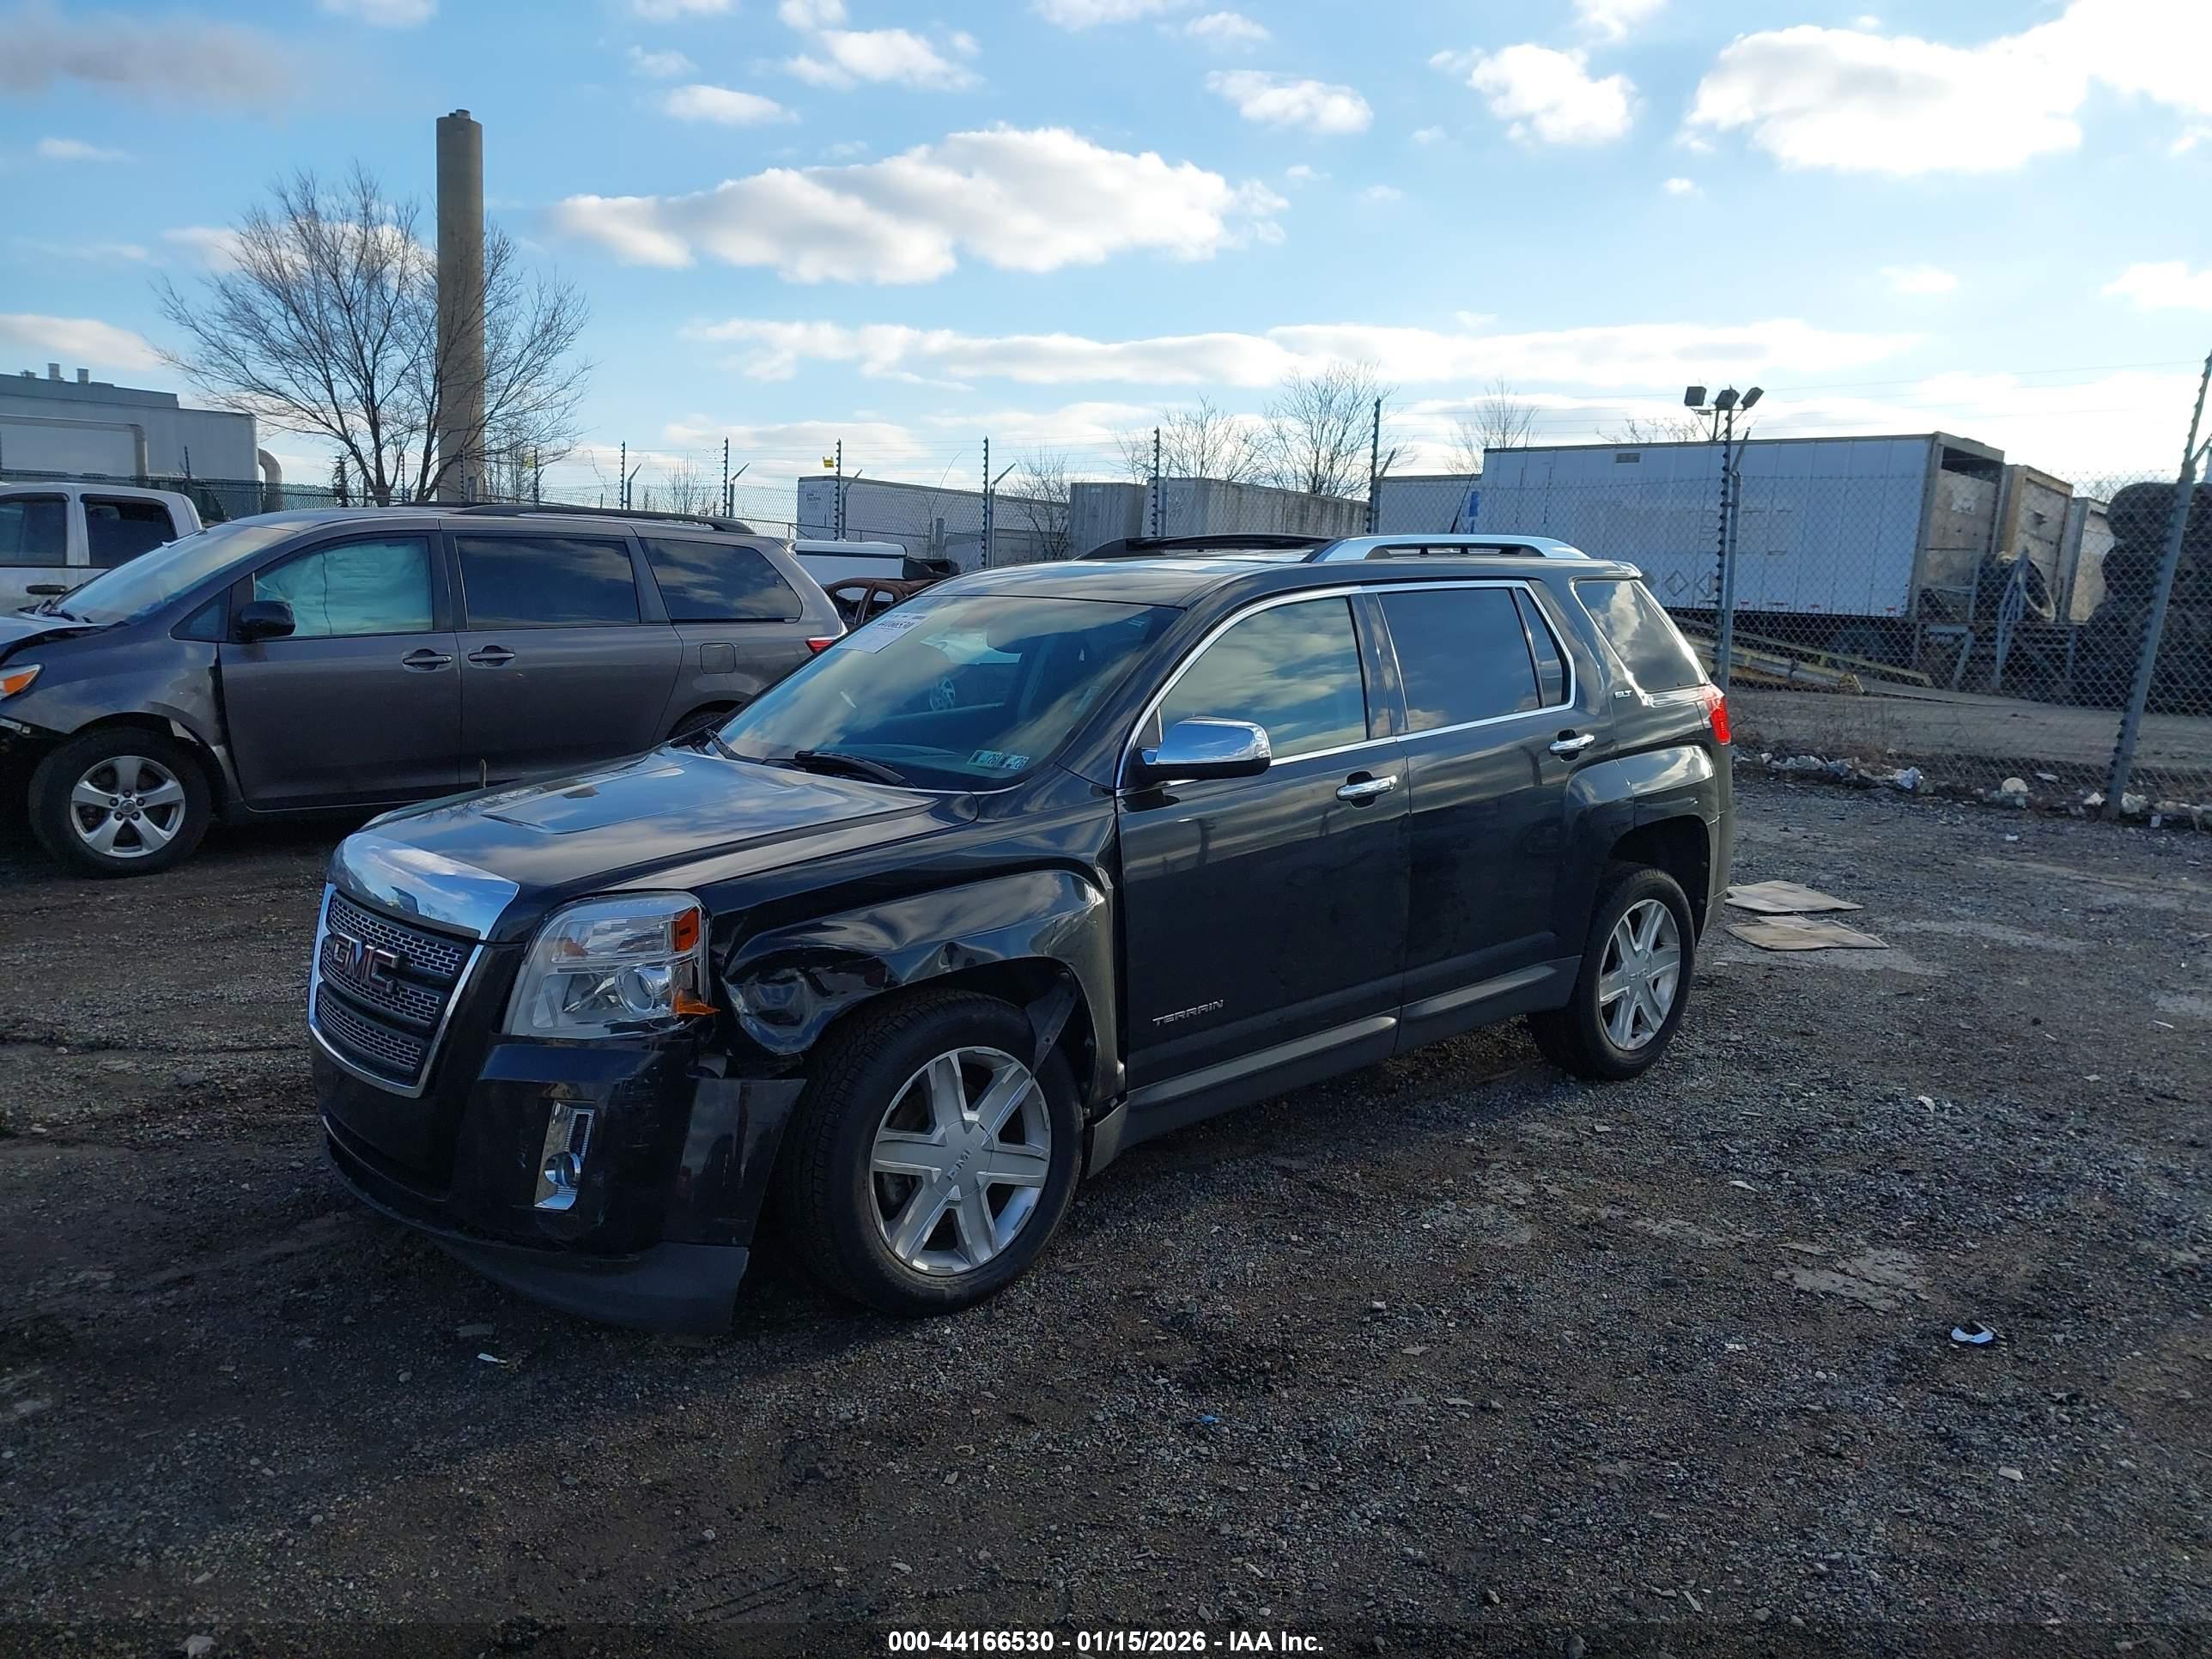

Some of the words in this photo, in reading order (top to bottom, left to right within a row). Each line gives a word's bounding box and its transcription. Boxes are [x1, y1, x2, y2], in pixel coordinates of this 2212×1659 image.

[1614, 690, 1632, 698] SLT
[330, 932, 398, 993] GMC
[1152, 1000, 1224, 1026] TERRAIN
